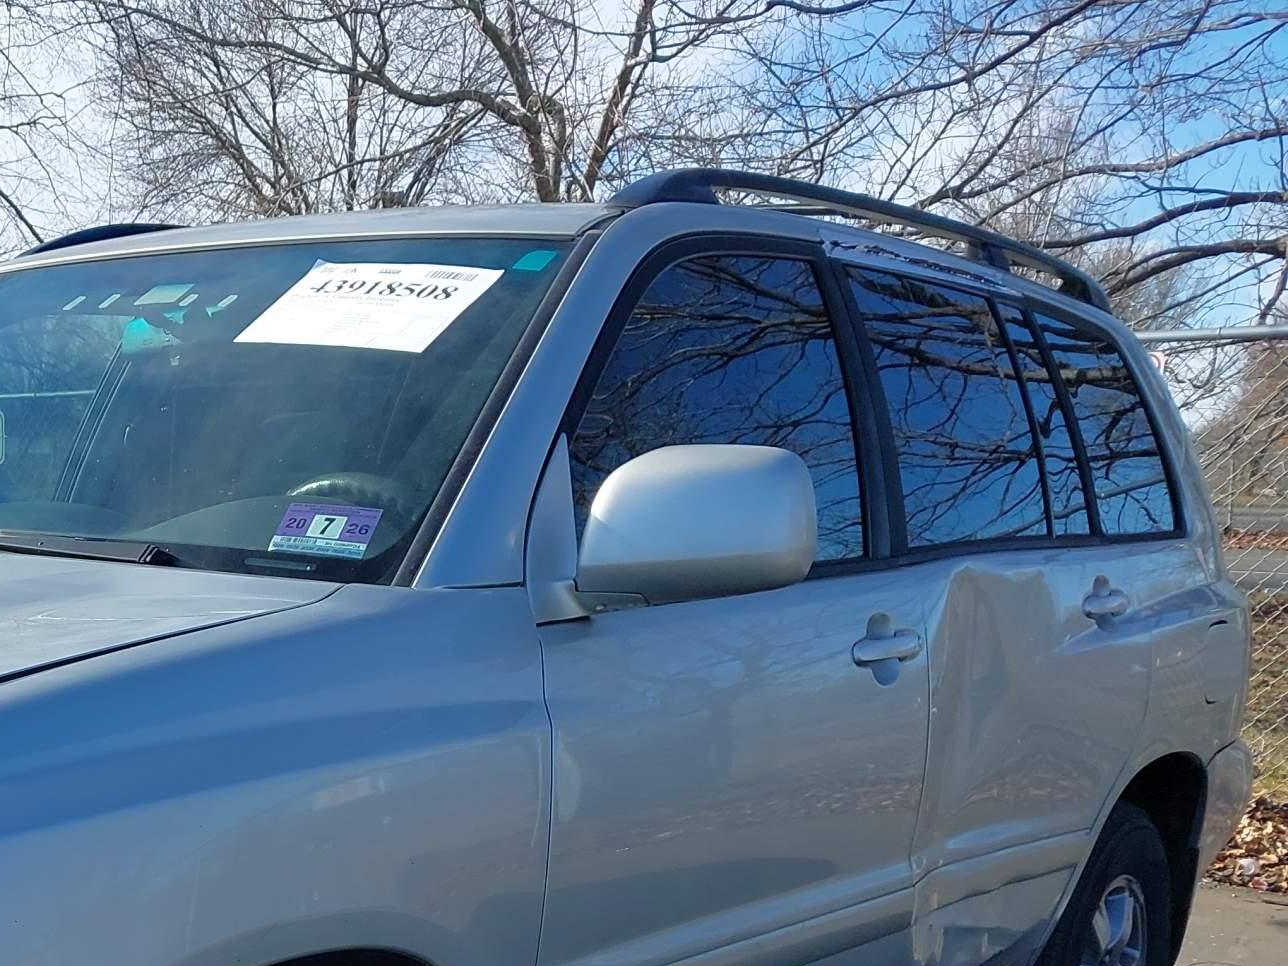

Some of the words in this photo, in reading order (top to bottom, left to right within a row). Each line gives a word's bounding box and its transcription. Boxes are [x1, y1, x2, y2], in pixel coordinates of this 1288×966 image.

[310, 278, 459, 301] 43918508
[285, 517, 308, 530] 20
[319, 517, 337, 535] 7
[346, 523, 370, 536] 26
